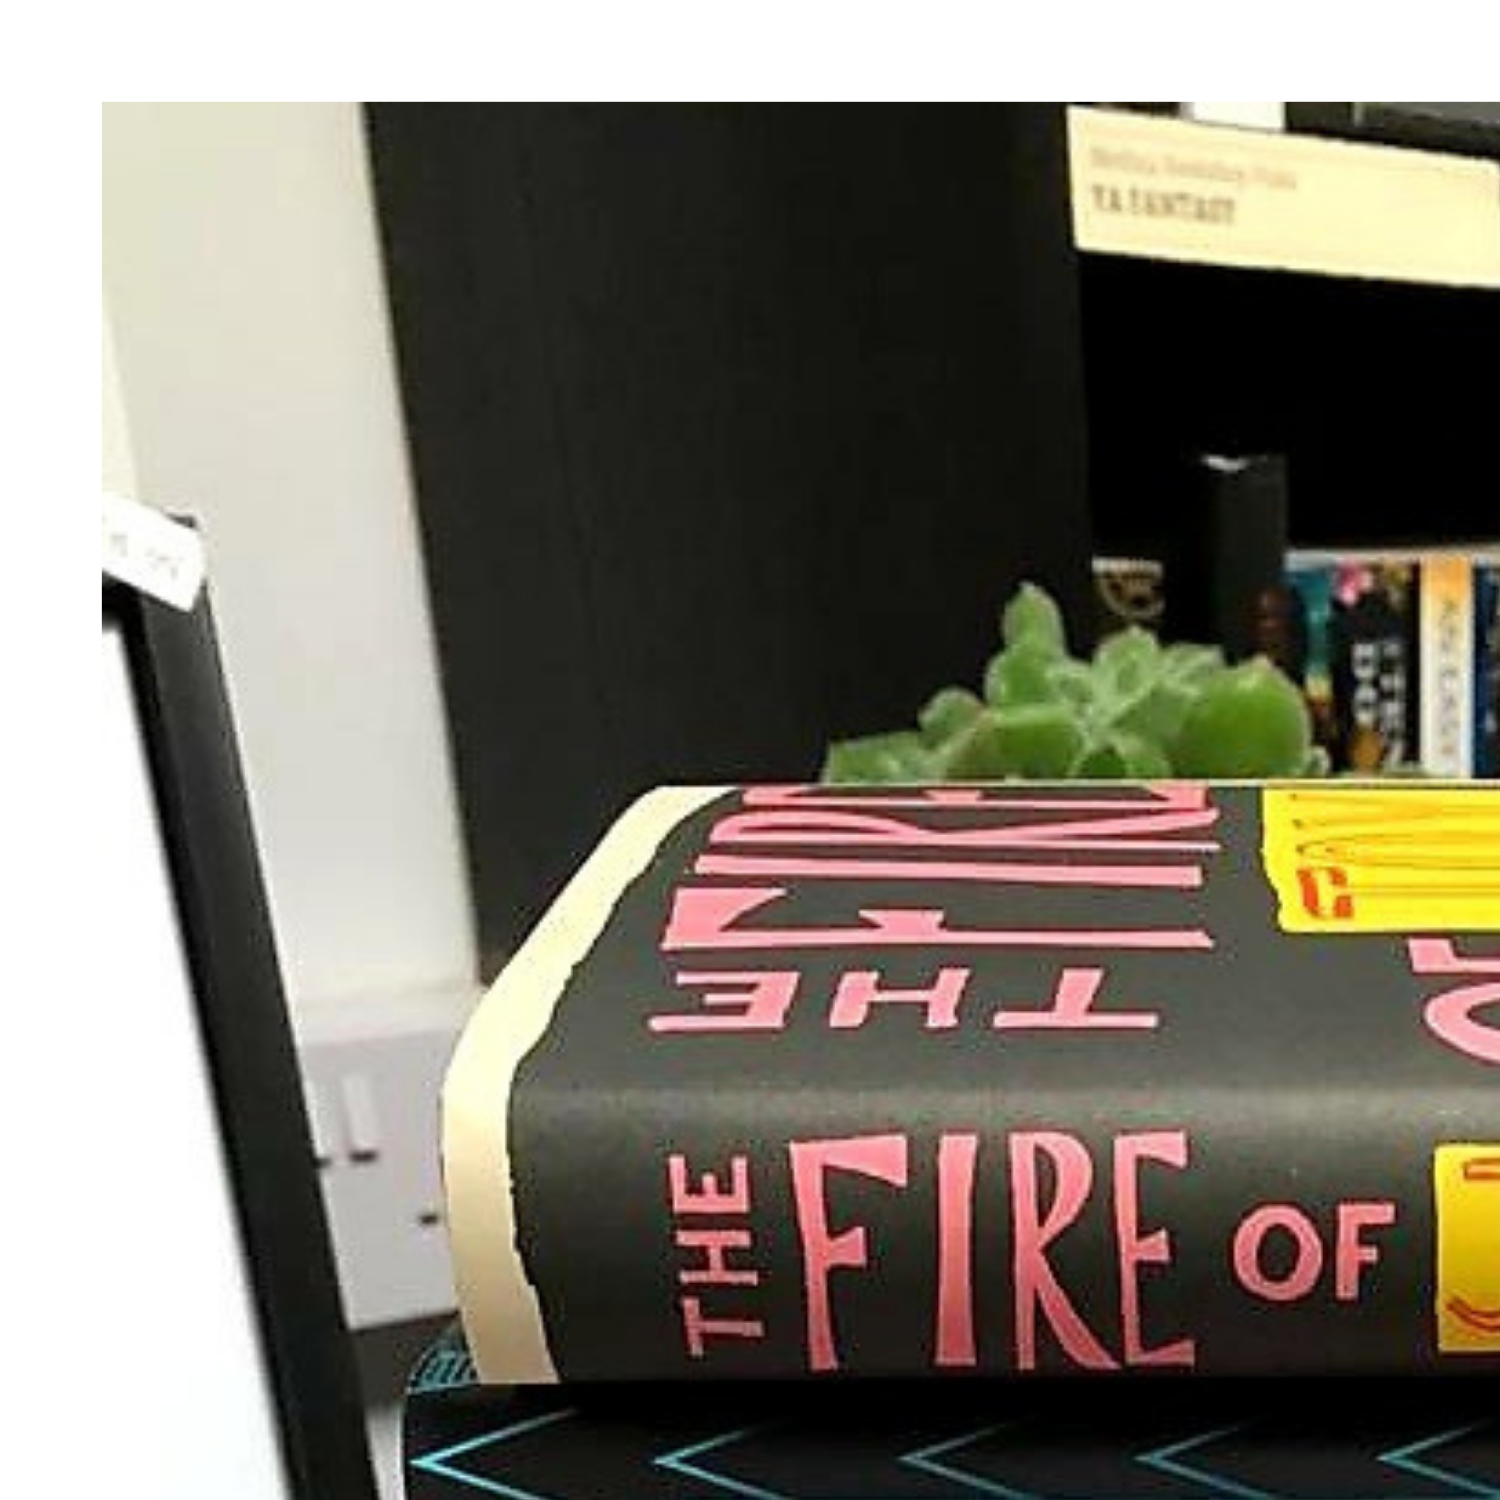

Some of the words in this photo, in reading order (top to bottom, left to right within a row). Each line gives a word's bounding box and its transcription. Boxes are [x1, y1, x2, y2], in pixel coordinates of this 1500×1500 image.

[667, 1153, 765, 1357] THE
[788, 1130, 1197, 1373] FIRE
[1232, 1200, 1397, 1303] OF
